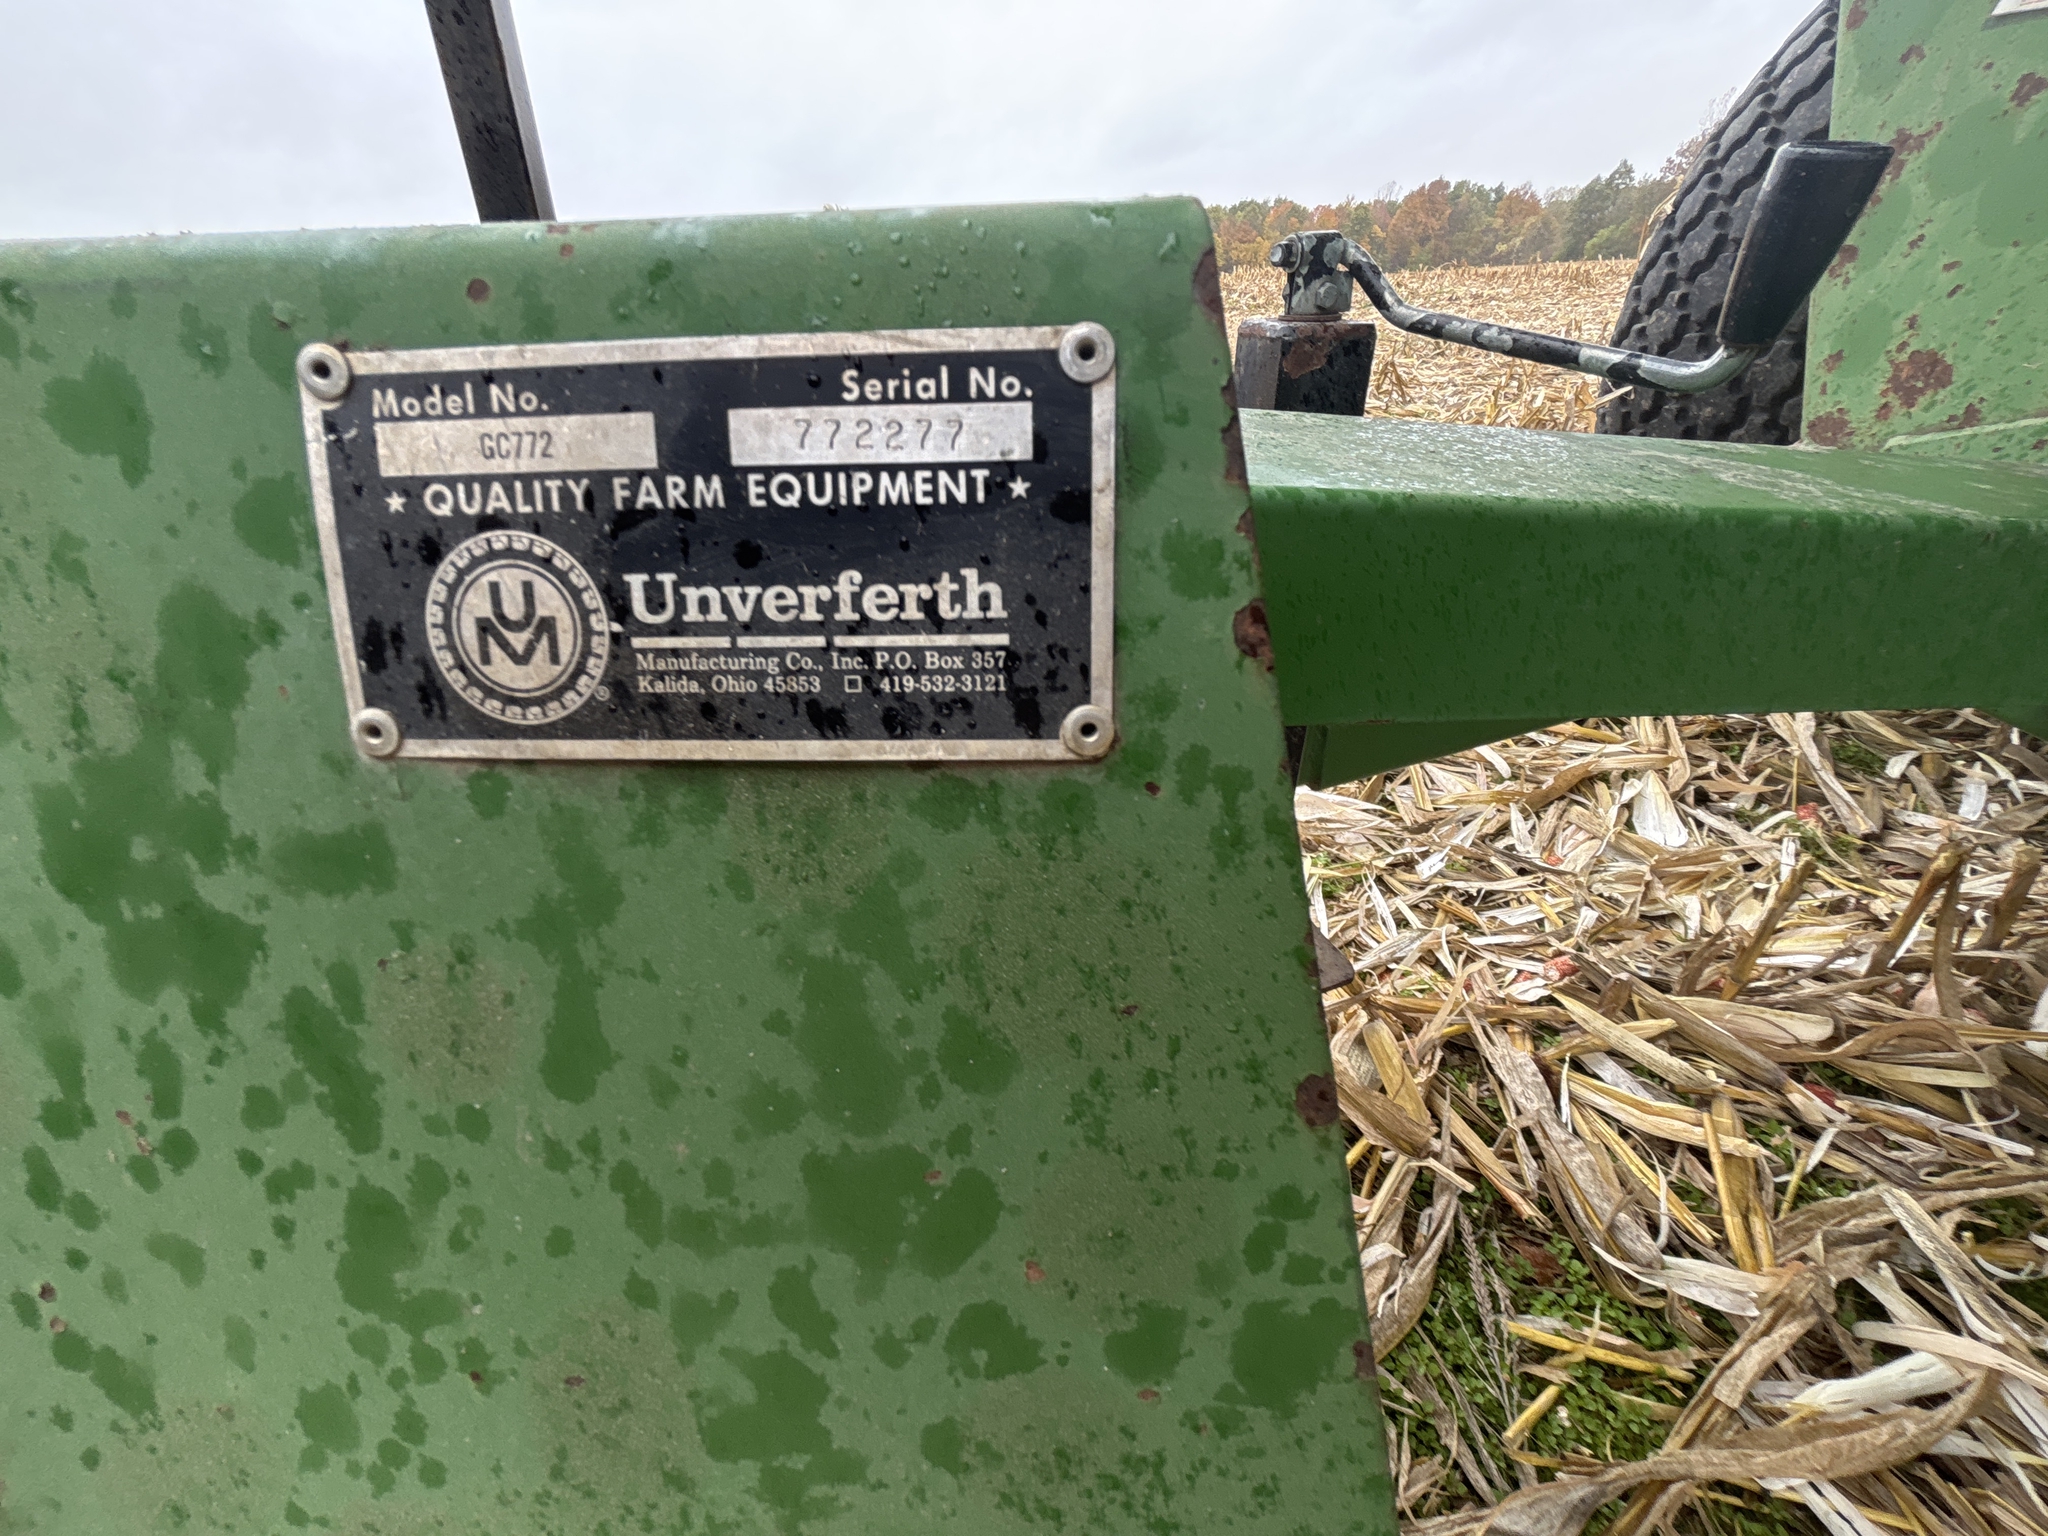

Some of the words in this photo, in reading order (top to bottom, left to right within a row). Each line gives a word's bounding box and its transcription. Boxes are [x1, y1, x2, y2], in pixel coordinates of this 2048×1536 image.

[372, 381, 476, 418] Model
[489, 382, 549, 414] No.
[841, 365, 949, 401] Serial
[968, 366, 1033, 399] No.
[479, 430, 554, 460] GC772
[794, 418, 964, 451] 772277
[423, 477, 590, 517] QUALITY
[611, 473, 726, 511] FARM
[747, 469, 990, 508] EQUIPMENT
[622, 567, 1008, 624] Unverferth
[635, 652, 780, 674] Manufacturing
[785, 651, 824, 672] Co.,
[831, 651, 869, 671] Inc.
[875, 651, 917, 670] P.O.
[924, 651, 965, 670] Box
[971, 651, 1007, 669] 357
[637, 675, 706, 695] Kalida,
[711, 675, 758, 693] Ohio
[763, 675, 821, 693] 45853
[879, 675, 1007, 693] 419-532-3121
